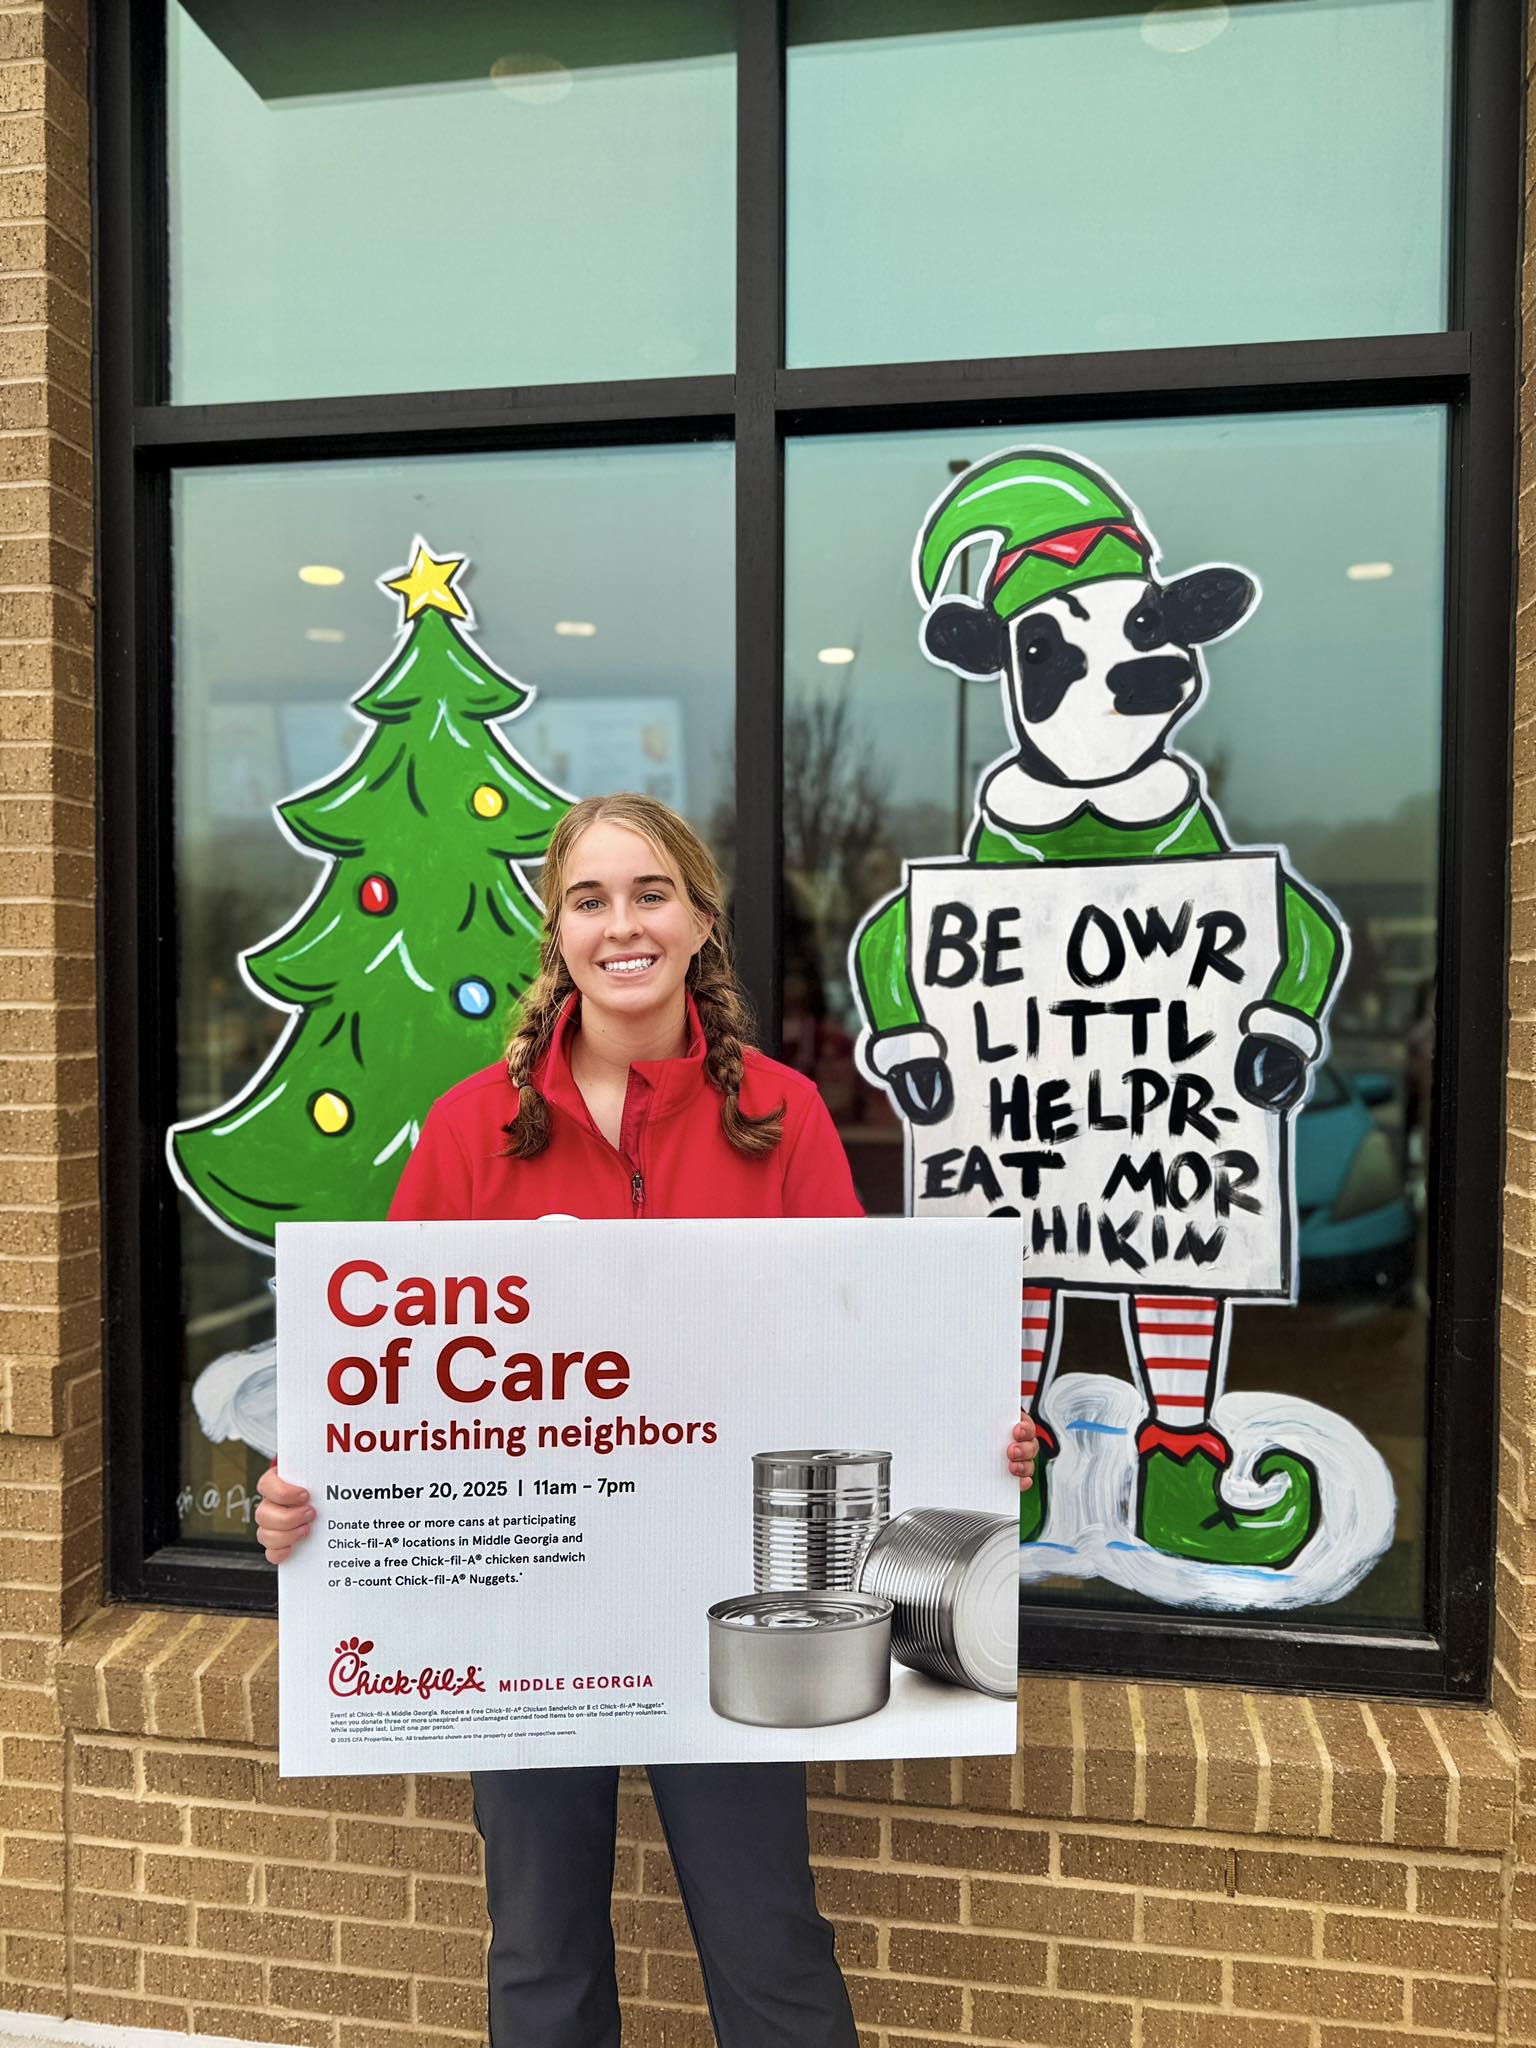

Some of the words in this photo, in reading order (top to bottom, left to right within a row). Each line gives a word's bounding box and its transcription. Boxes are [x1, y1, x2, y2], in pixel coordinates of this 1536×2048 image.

[924, 901, 1024, 988] BE
[1066, 898, 1248, 990] OWR
[973, 996, 1217, 1064] LITTL
[982, 1068, 1240, 1144] HELPR-
[920, 1146, 1066, 1202] EAT
[1101, 1149, 1263, 1218] MOR
[327, 1260, 530, 1327] Cans
[327, 1337, 412, 1405] of
[437, 1336, 630, 1402] Care
[326, 1419, 526, 1456] Nourishing
[538, 1416, 717, 1454] neighbors
[326, 1484, 424, 1500] November
[429, 1483, 457, 1500] 20,
[463, 1481, 507, 1497] 2025
[534, 1480, 576, 1495] 11am
[598, 1478, 635, 1497] 7pm
[328, 1520, 370, 1530] Donate
[374, 1520, 404, 1528] three
[424, 1520, 454, 1528] more
[458, 1518, 484, 1526] cans
[488, 1516, 499, 1526] at
[504, 1514, 576, 1528] participating
[402, 1537, 455, 1548] locations
[459, 1536, 468, 1546] in
[472, 1535, 510, 1546] Middle
[514, 1534, 558, 1546] Georgia
[562, 1533, 582, 1543] and
[328, 1558, 370, 1568] receive
[384, 1557, 408, 1566] free
[486, 1554, 529, 1564] chicken
[533, 1552, 586, 1562] sandwich
[328, 1579, 340, 1587] or
[344, 1576, 392, 1586] 8-count
[329, 1650, 486, 1700] Chick-fil-A
[499, 1678, 564, 1692] MIDDLE
[573, 1675, 653, 1690] GEORGIA
